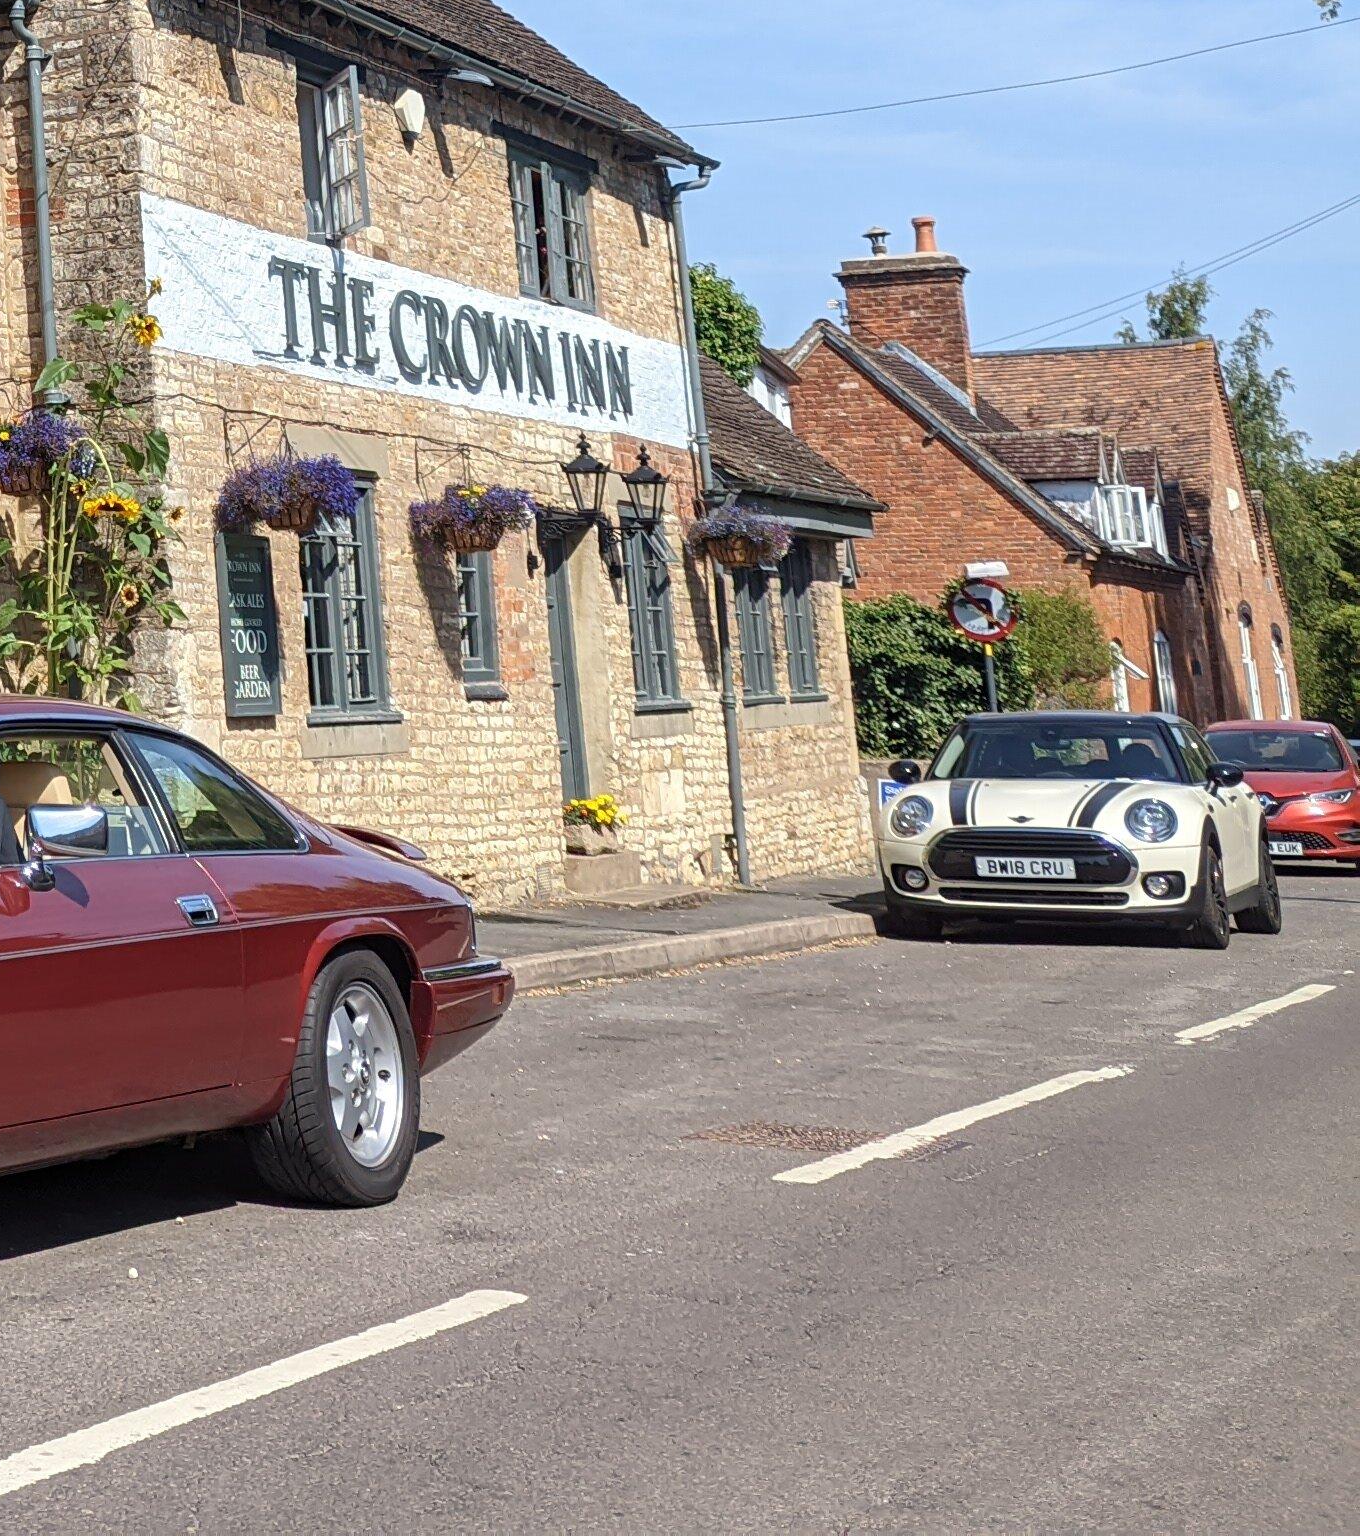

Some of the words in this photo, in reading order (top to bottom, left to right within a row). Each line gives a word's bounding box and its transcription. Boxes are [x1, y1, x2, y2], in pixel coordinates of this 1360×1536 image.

[268, 255, 380, 370] THE
[389, 289, 555, 402] CROWN
[558, 331, 633, 420] INN
[228, 592, 247, 608] ASK
[246, 593, 265, 609] ALES
[239, 664, 260, 680] BEER
[1277, 843, 1299, 853] EUK
[986, 859, 1025, 875] BW18
[1030, 861, 1064, 875] CRU
